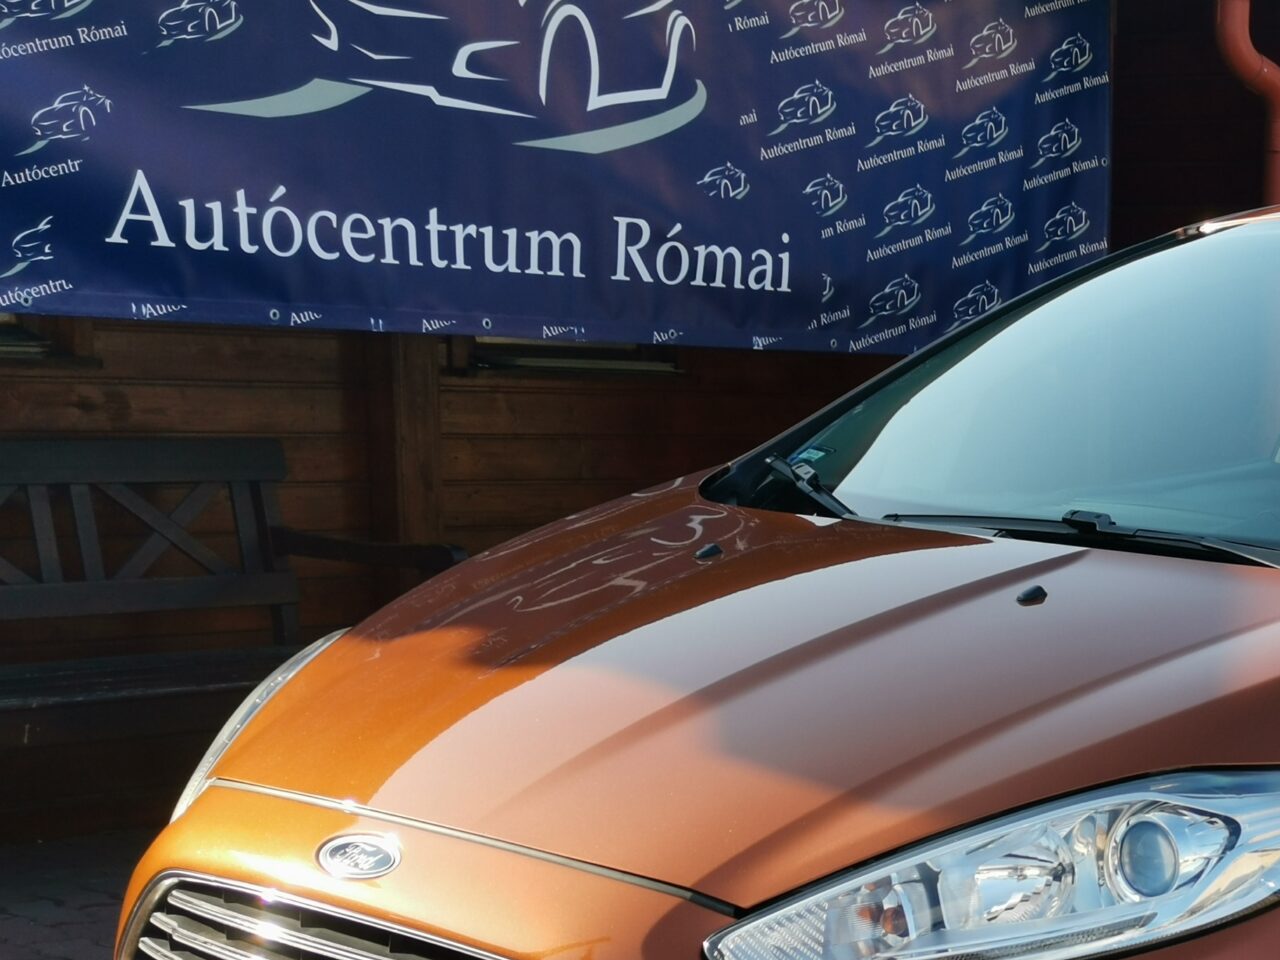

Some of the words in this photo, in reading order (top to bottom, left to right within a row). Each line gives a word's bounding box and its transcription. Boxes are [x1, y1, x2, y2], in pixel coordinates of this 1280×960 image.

[0, 34, 75, 60] ócentrum
[77, 20, 128, 44] Római
[734, 11, 770, 31] Római
[770, 38, 835, 64] Autócentrum
[836, 28, 867, 48] Római
[868, 54, 925, 79] Autócentrum
[926, 43, 955, 62] Római
[955, 67, 1009, 93] Autócentrum
[1009, 57, 1036, 75] Római
[1034, 81, 1082, 105] Autócentrum
[1083, 71, 1110, 88] Római
[759, 133, 824, 161] Autócentrum
[825, 122, 857, 142] Római
[856, 147, 916, 172] Autócentrum
[917, 133, 946, 153] Római
[944, 157, 997, 183] Autócentrum
[998, 144, 1024, 164] Római
[1022, 166, 1071, 192] Autócentrum
[1072, 155, 1099, 173] Római
[105, 169, 586, 279] Autócentrum
[610, 216, 792, 293] Római
[835, 213, 867, 235] Római
[866, 234, 924, 262] Autócentrum
[924, 221, 952, 242] Római
[951, 241, 1003, 269] Autócentrum
[1004, 230, 1029, 249] Római
[1027, 249, 1078, 276] Autócentrum
[1079, 237, 1108, 256] Római
[820, 305, 851, 326] Római
[848, 323, 907, 353] Autócentrum
[908, 310, 937, 331] Római
